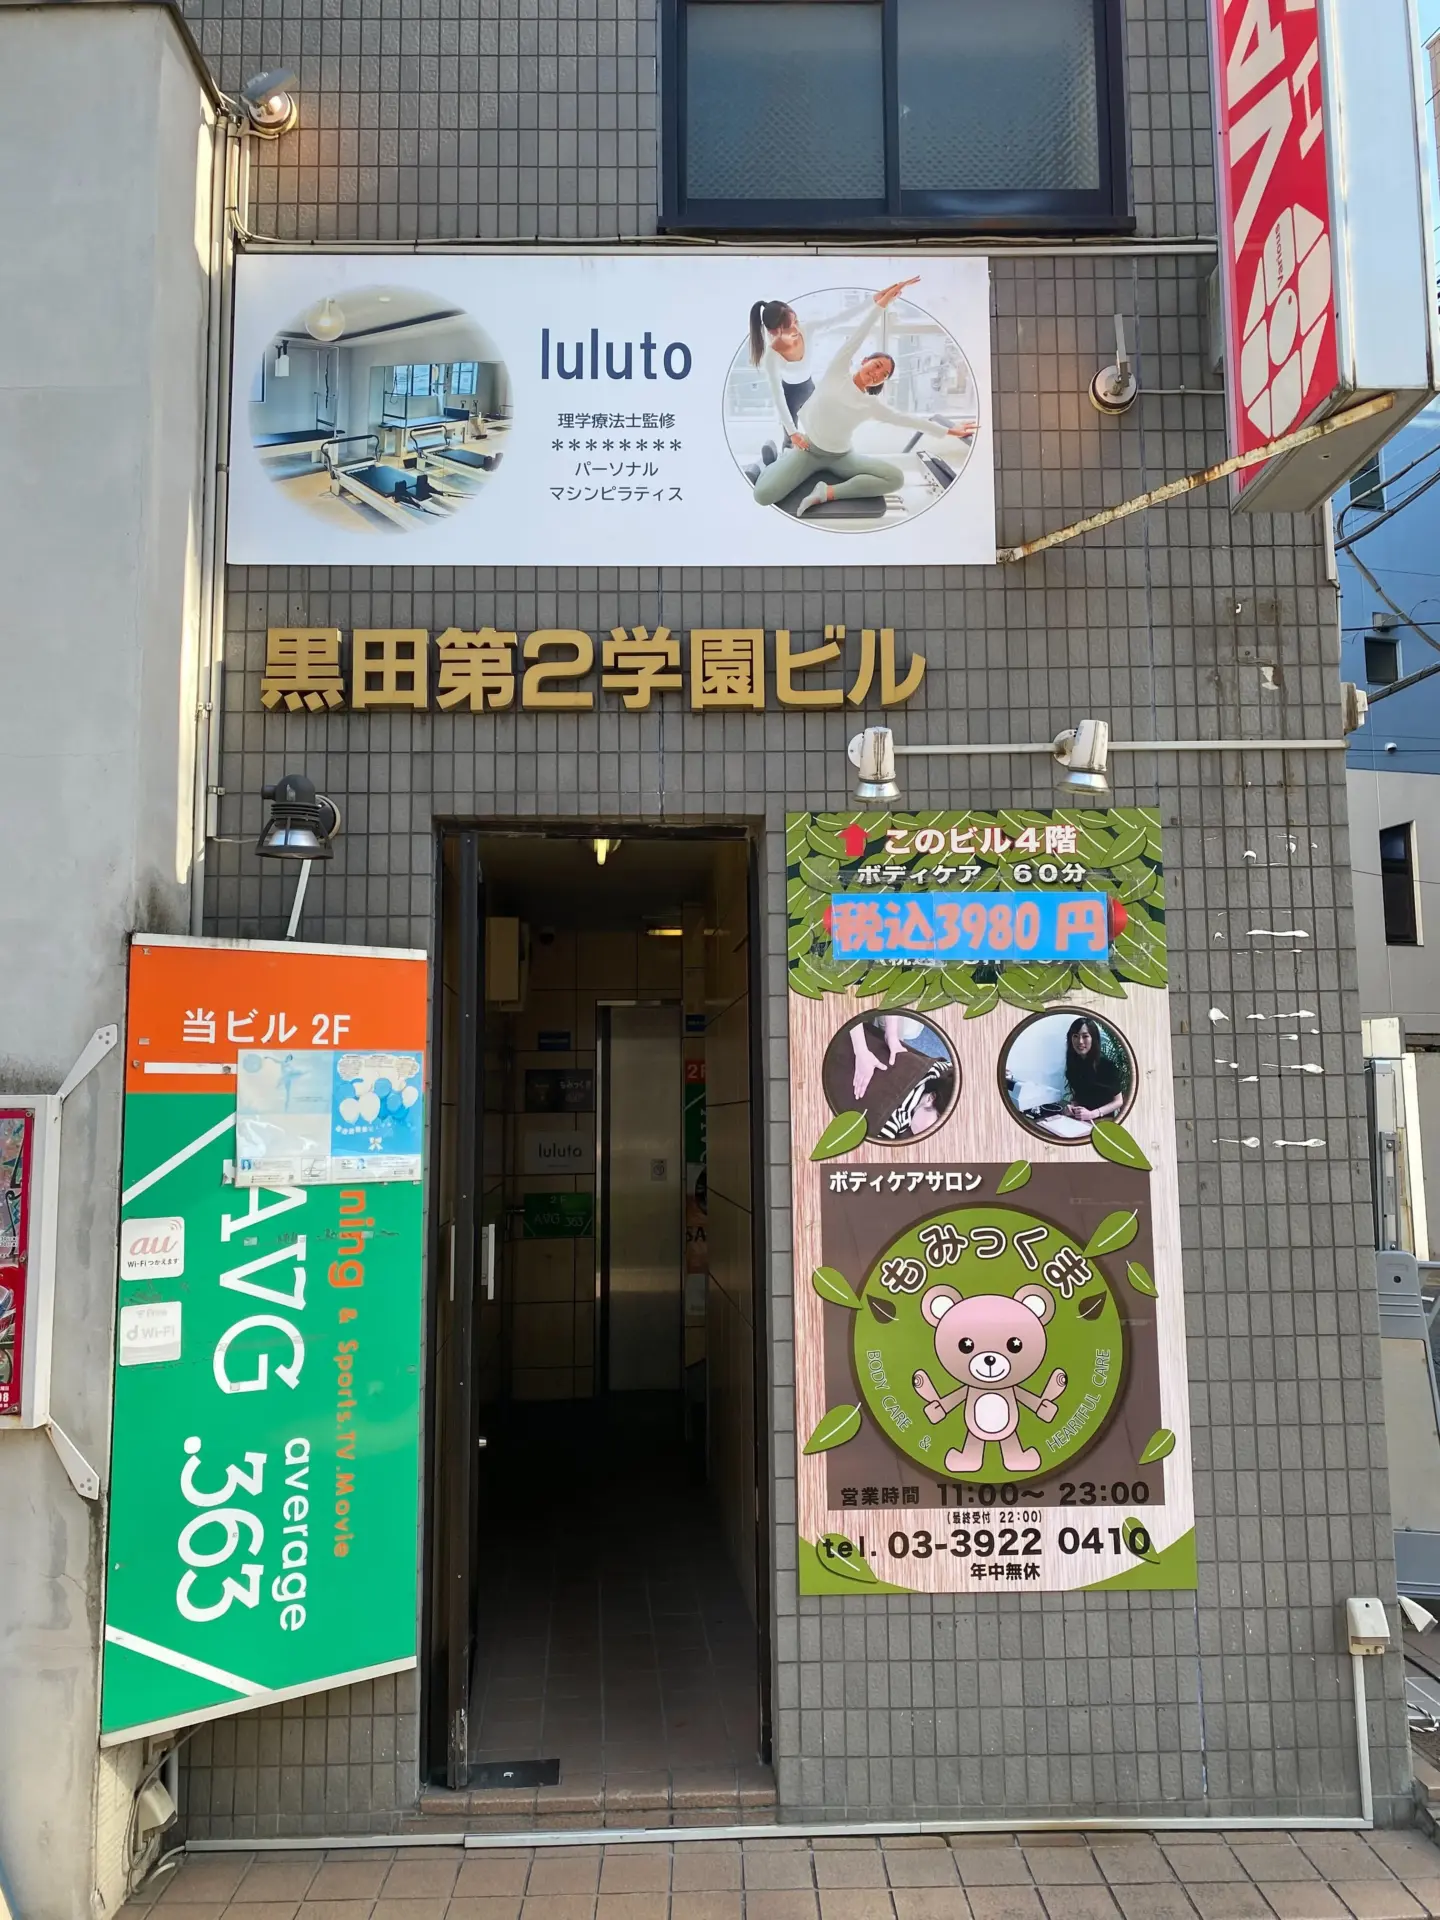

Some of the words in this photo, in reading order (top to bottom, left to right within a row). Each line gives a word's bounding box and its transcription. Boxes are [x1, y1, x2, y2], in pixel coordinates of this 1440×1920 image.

[1224, 0, 1294, 264] VA
[1274, 223, 1285, 289] Various
[540, 328, 693, 381] luluto
[557, 412, 676, 431] 理学療法士監修
[574, 460, 659, 478] パーソナル
[548, 484, 684, 502] マシンピラティス
[260, 624, 926, 713] 黒田第2学園ビル
[884, 825, 1078, 855] このビル4階
[857, 863, 982, 885] ボディケア
[1013, 863, 1087, 884] 60分
[1055, 900, 1108, 952] 円
[182, 1007, 298, 1044] 当ビル
[312, 1013, 351, 1045] 2F
[538, 1142, 583, 1158] luluto
[829, 1171, 983, 1193] ボディケアサロン
[129, 1235, 179, 1257] au
[880, 1223, 1093, 1299] もみっくま
[338, 1308, 358, 1325] &
[142, 1325, 176, 1339] Wi-Fi
[865, 1349, 890, 1391] BODY
[881, 1394, 914, 1433] CARE
[918, 1434, 932, 1452] &
[1046, 1393, 1102, 1453] HEARTFUL
[1091, 1348, 1111, 1388] CARE
[840, 1486, 920, 1506] 営業時間
[1059, 1481, 1150, 1506] 23:00
[271, 1437, 311, 1632] average
[822, 1536, 877, 1558] tel.
[887, 1528, 1042, 1559] 03-3922
[1057, 1526, 1151, 1556] 0410
[970, 1562, 1041, 1581] 年中無休
